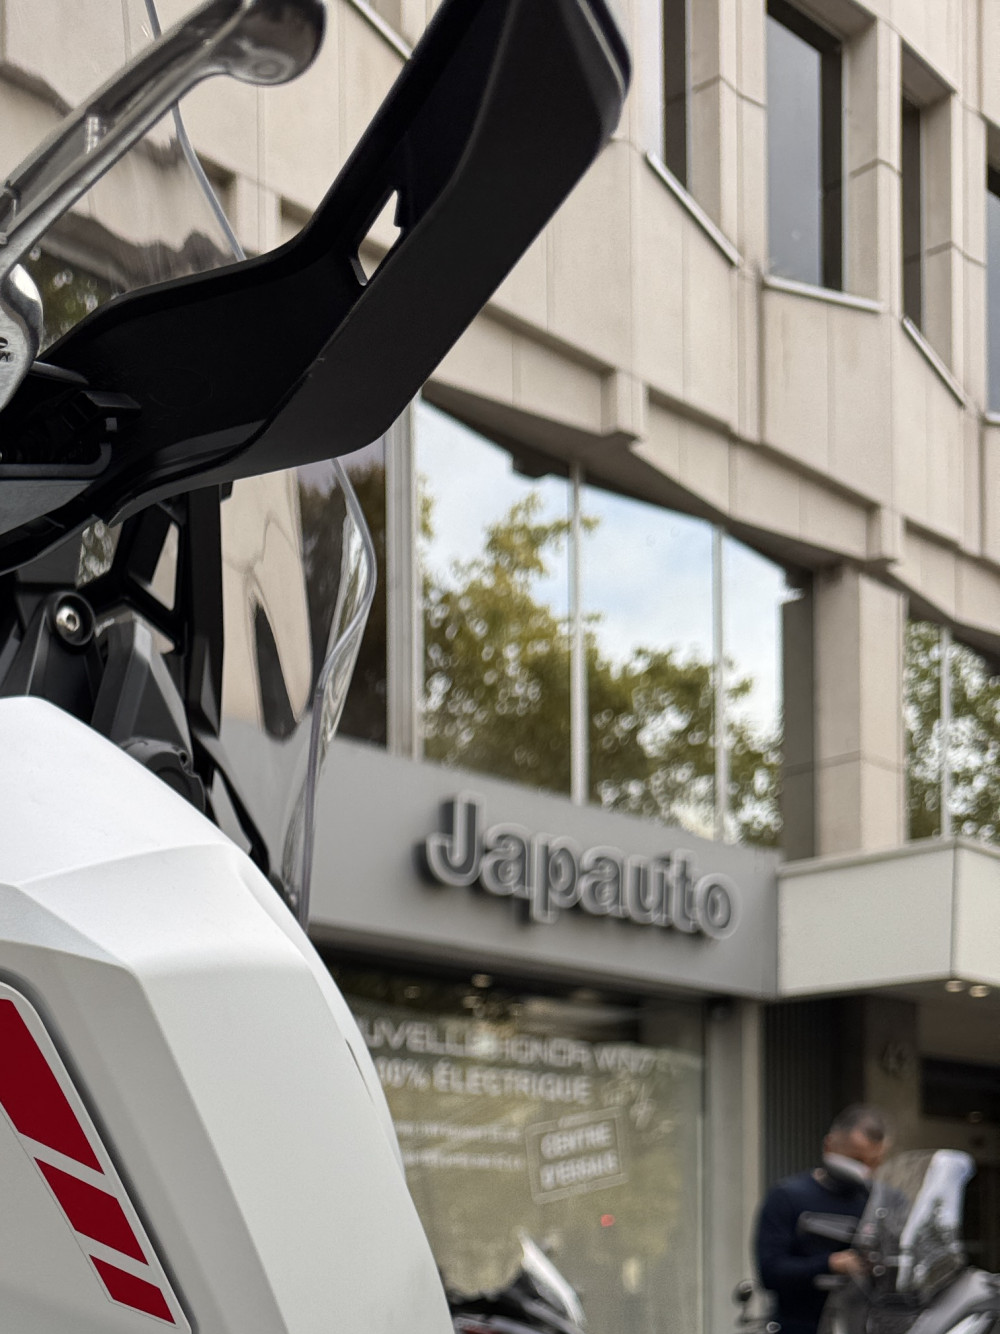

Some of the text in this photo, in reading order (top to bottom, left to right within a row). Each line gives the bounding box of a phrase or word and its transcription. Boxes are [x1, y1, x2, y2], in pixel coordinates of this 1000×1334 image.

[424, 789, 742, 939] Japauto
[376, 1056, 430, 1090] 00%
[433, 1055, 592, 1105] ÉLECTRIQUE
